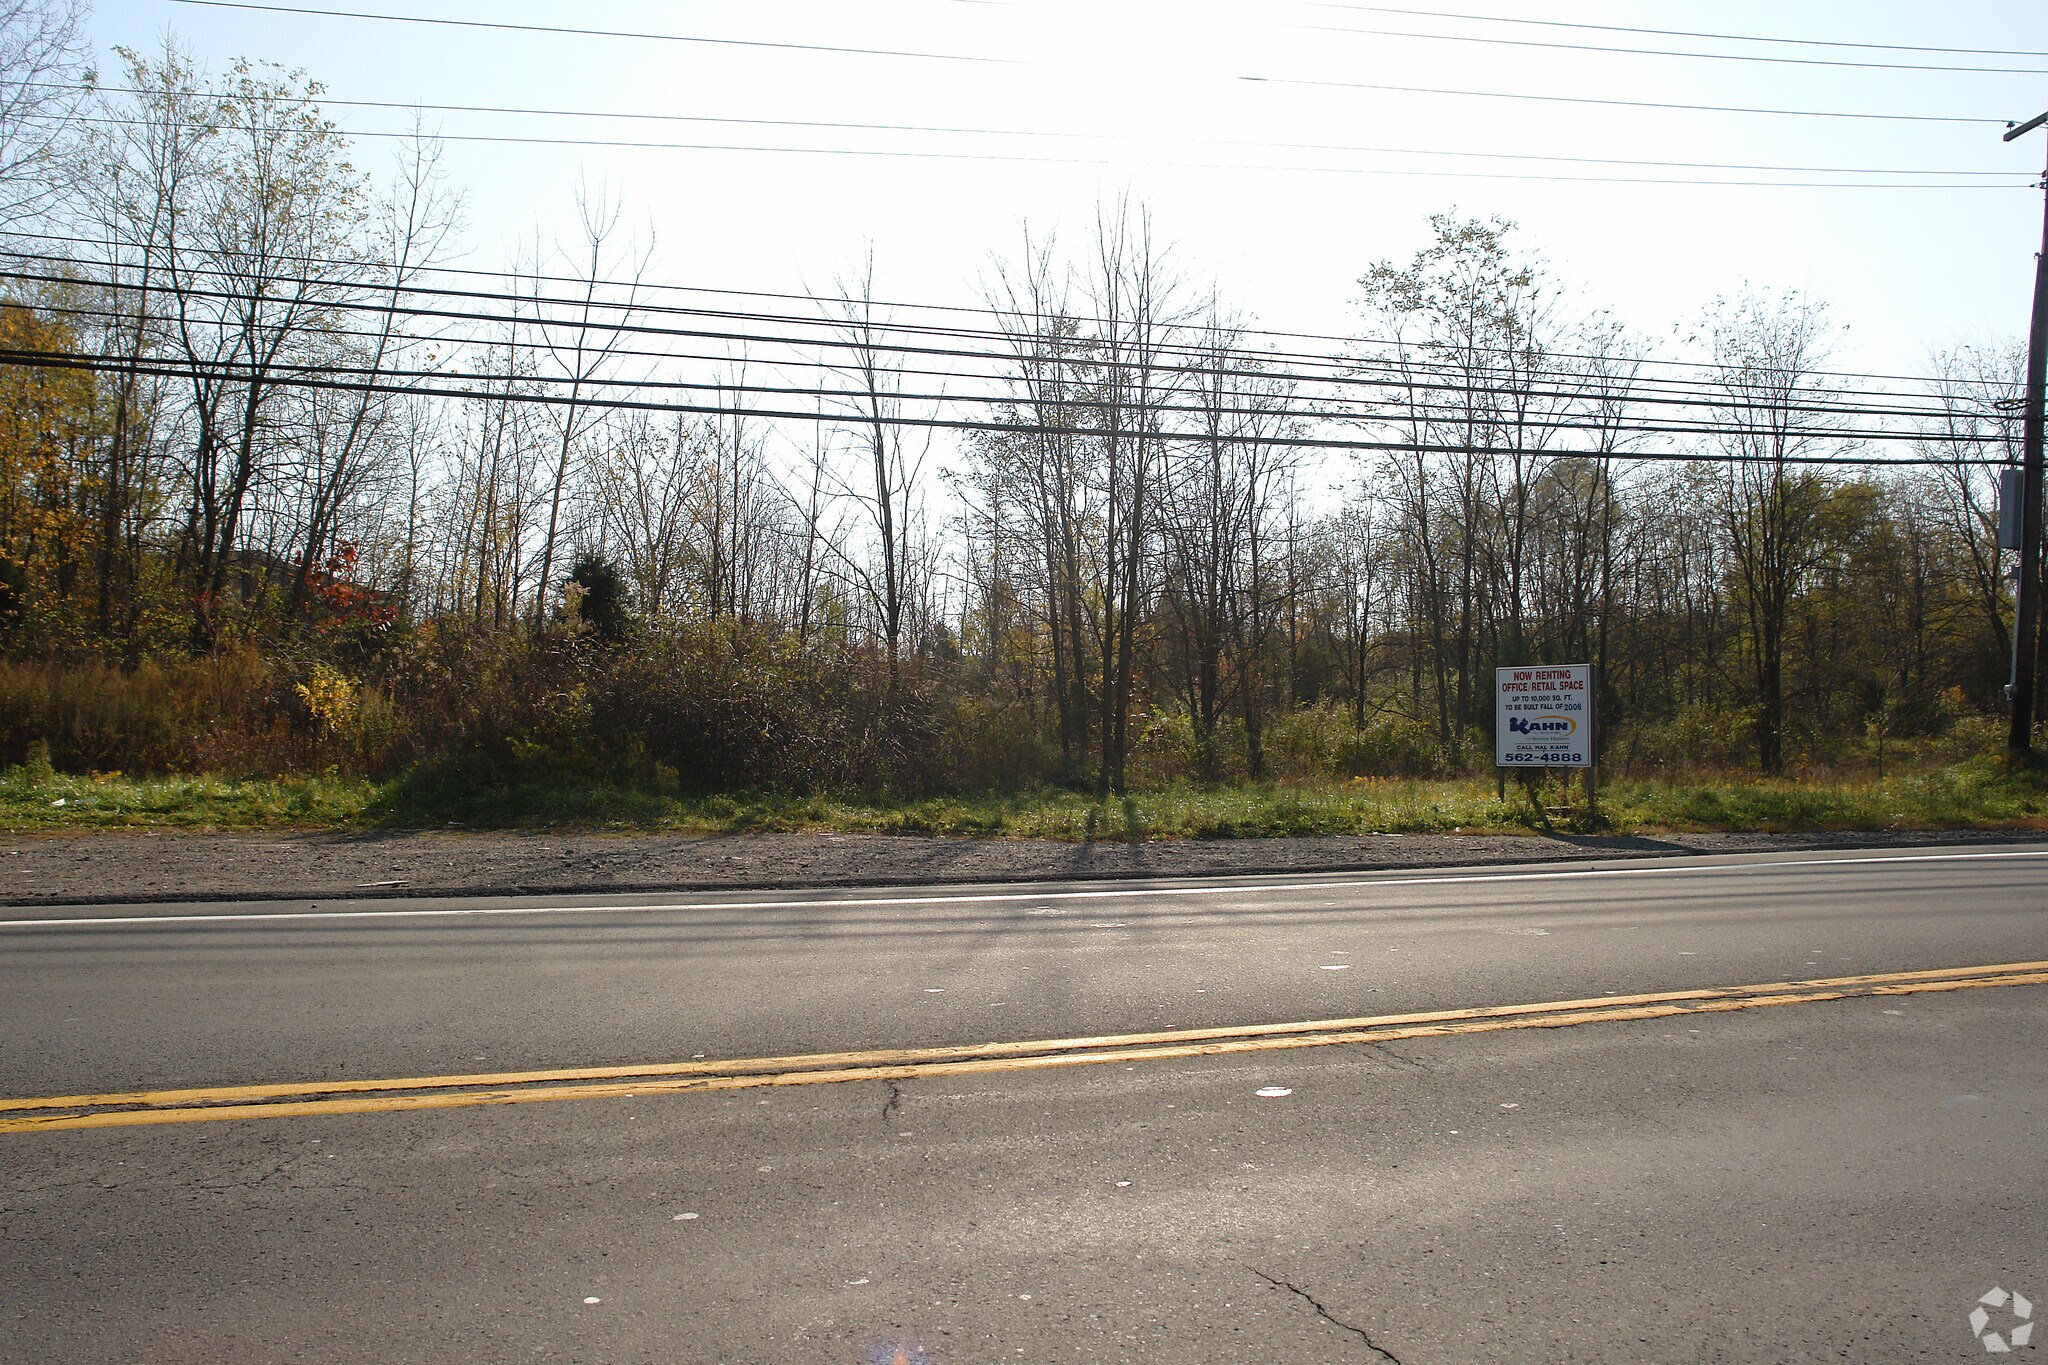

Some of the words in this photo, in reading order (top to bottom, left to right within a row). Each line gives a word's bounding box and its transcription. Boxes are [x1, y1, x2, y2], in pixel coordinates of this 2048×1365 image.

[1514, 671, 1532, 681] NOW
[1536, 670, 1571, 680] RENTING
[1559, 681, 1584, 691] SPACE
[1564, 703, 1582, 711] 2006
[1509, 717, 1568, 735] KAHN
[1505, 753, 1582, 762] 562-4888
